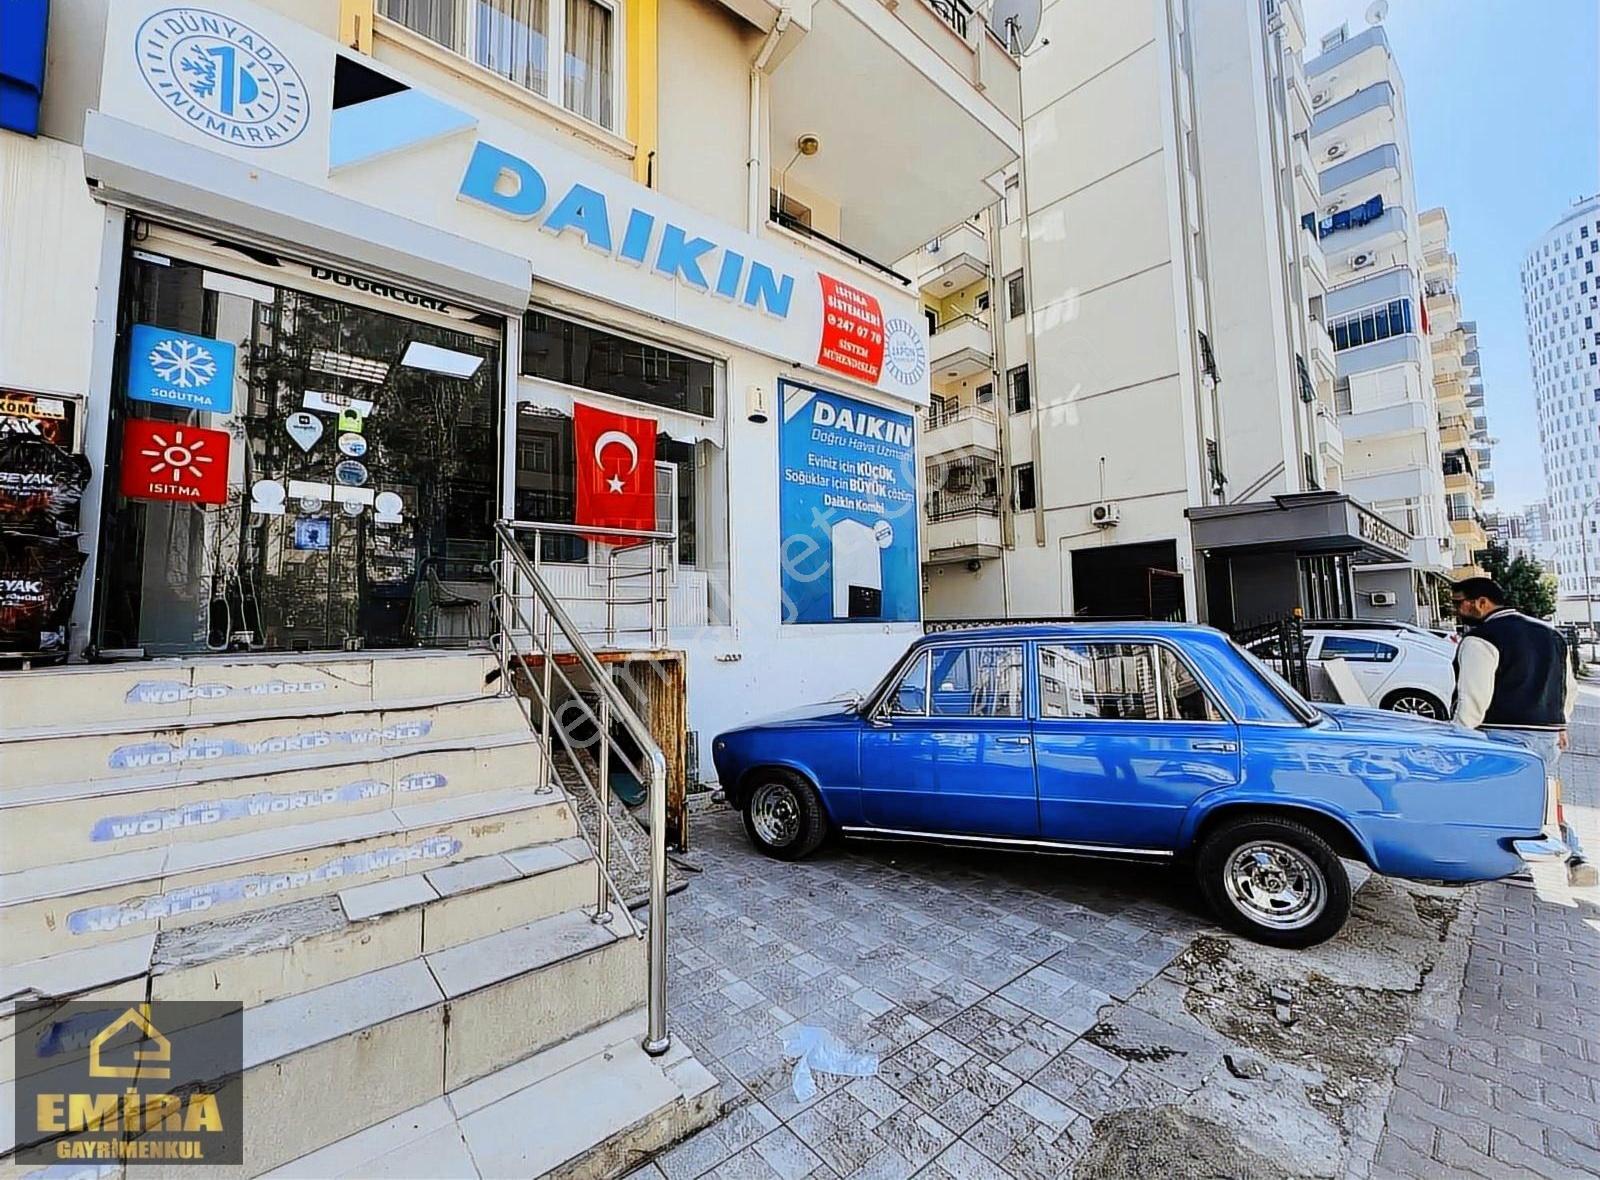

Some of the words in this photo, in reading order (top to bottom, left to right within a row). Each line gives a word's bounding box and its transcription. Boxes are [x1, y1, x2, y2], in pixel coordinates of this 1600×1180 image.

[164, 11, 286, 75] DÜNYADA
[166, 91, 281, 142] NUMARA
[456, 140, 796, 321] DAIKIN
[150, 387, 213, 405] SOĞUTMA
[812, 400, 913, 447] DAIKIN
[811, 428, 847, 446] Doğru
[848, 438, 875, 454] Hava
[808, 453, 838, 470] Eviniz
[149, 482, 201, 497] ISITMA
[785, 469, 829, 487] Soğuklar
[849, 478, 886, 497] BÜYÜK
[824, 494, 854, 509] Daikin
[855, 499, 885, 514] Kombi
[251, 681, 328, 696] WORLD
[126, 746, 225, 769] WORLD
[249, 734, 331, 755] WORLD
[111, 809, 221, 839] WORLD
[250, 788, 340, 817] WORLD
[359, 776, 437, 800] WRLD
